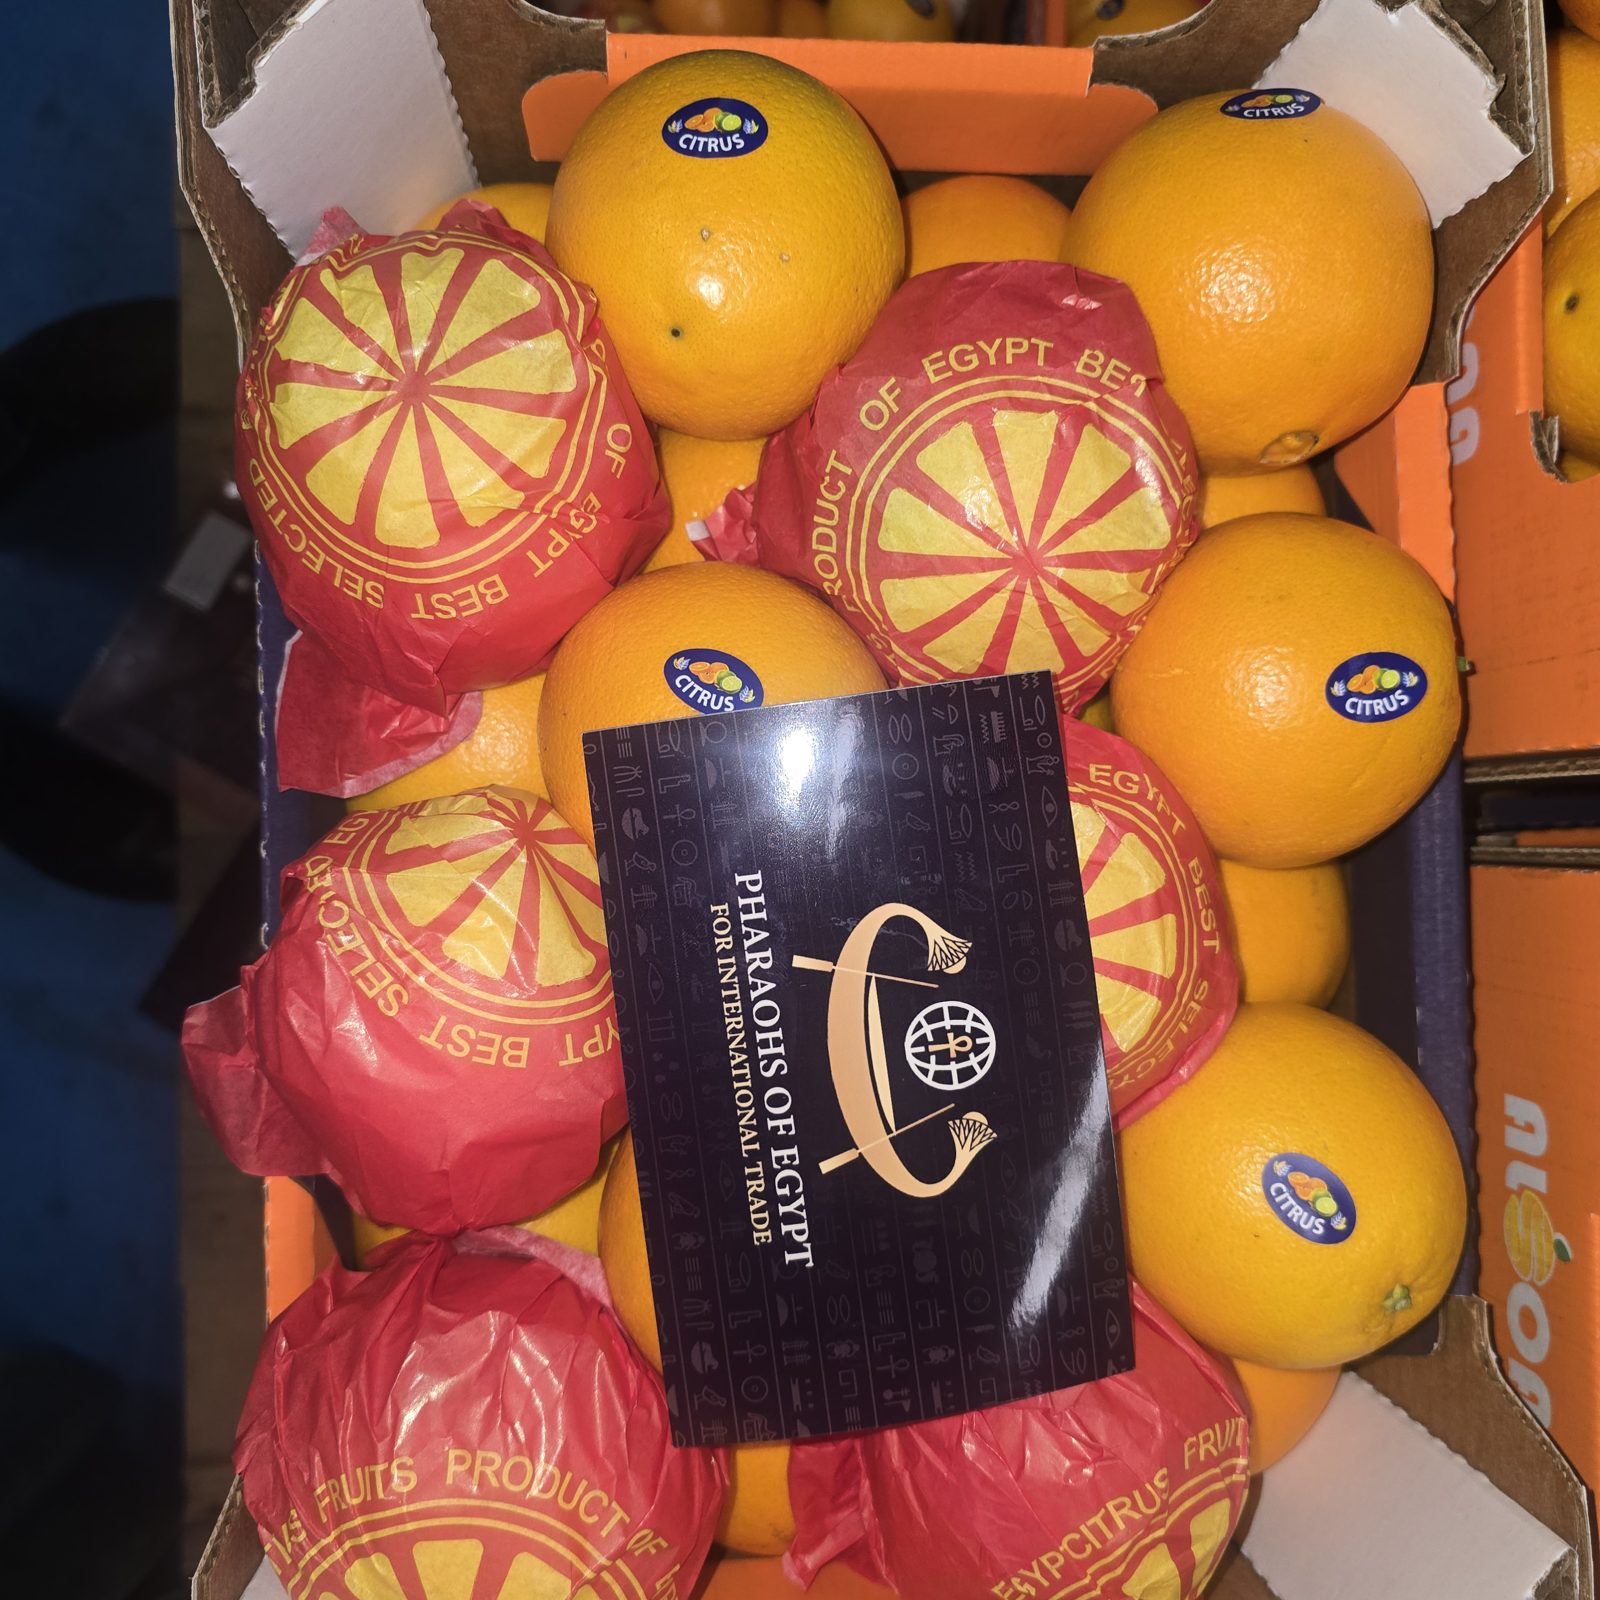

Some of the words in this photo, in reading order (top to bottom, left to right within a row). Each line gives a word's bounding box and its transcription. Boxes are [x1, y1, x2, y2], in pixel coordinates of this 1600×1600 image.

[1243, 103, 1305, 118] CITRUS
[678, 133, 745, 153] CITRUS
[859, 378, 903, 432] OF
[921, 337, 1054, 385] EGYPT
[606, 423, 633, 480] OF
[249, 457, 385, 609] SELECTED
[525, 492, 602, 578] EGYPT
[410, 573, 510, 621] BEST
[674, 674, 735, 712] CITRUS
[1344, 689, 1410, 716] CITRUS
[1088, 763, 1188, 836] EGYPT
[1187, 856, 1220, 955] BEST
[710, 902, 734, 954] FOR
[734, 869, 788, 1078] PHARAOHS
[418, 1015, 531, 1069] BEST
[717, 955, 761, 1158] INTERNATIONAL
[763, 1086, 796, 1136] OF
[744, 1160, 773, 1246] TRADE
[770, 1144, 815, 1268] EGYPT
[1269, 1182, 1326, 1235] CITRUS
[313, 1457, 418, 1523] FRUITS
[445, 1448, 631, 1538] PRODUCT
[626, 1528, 669, 1557] OF
